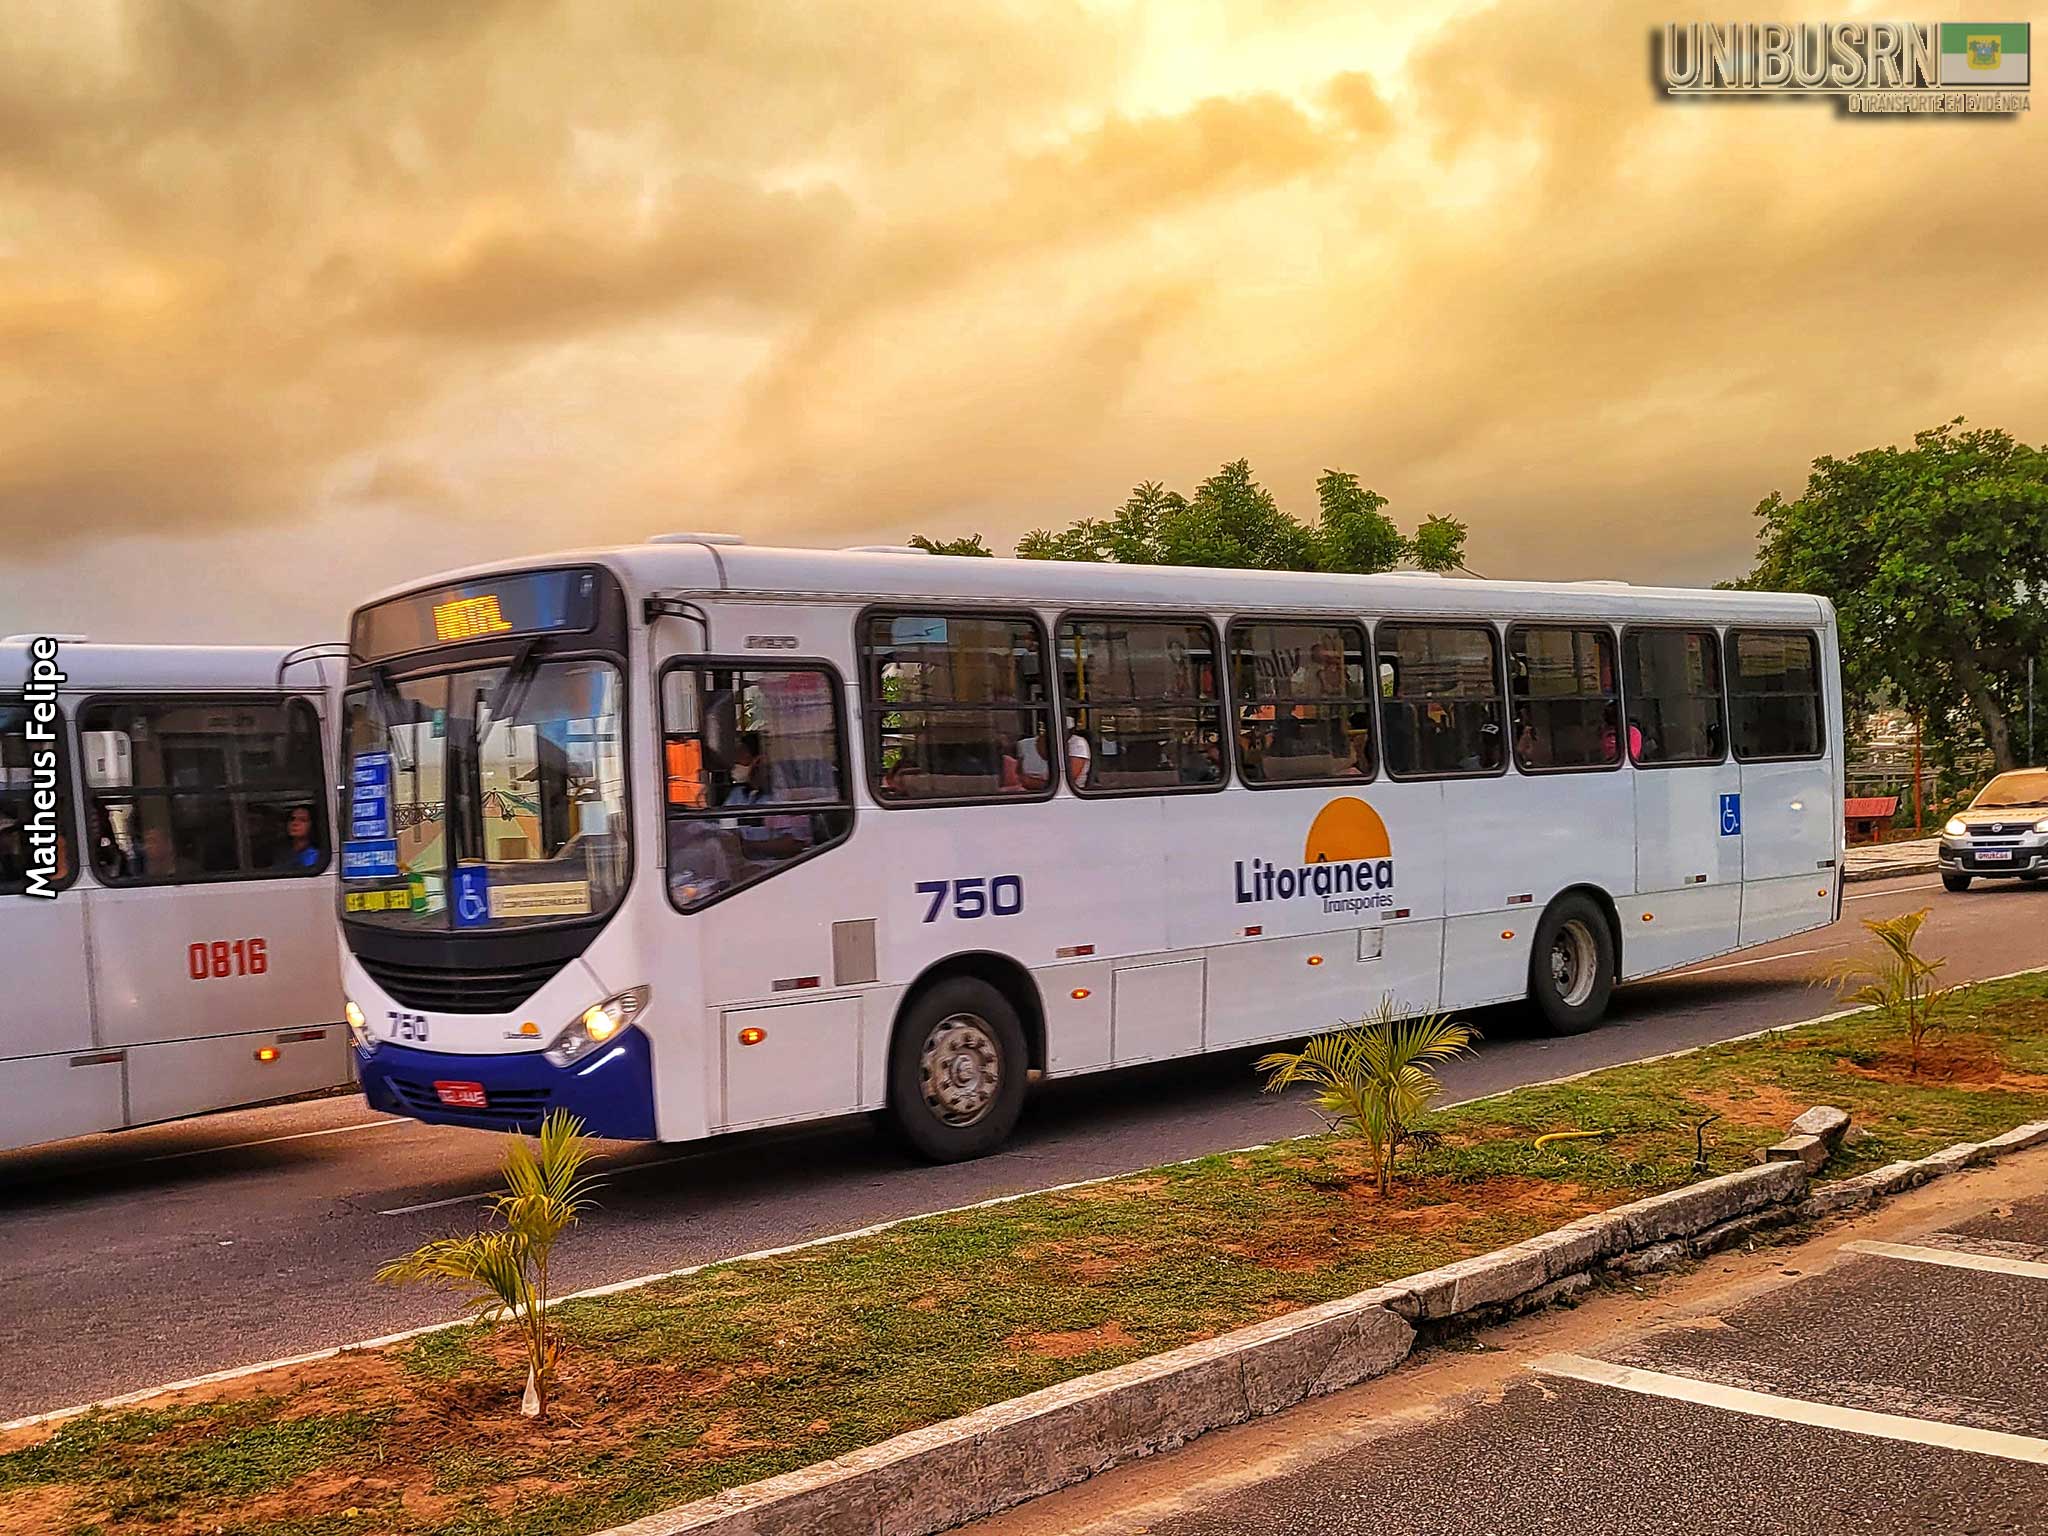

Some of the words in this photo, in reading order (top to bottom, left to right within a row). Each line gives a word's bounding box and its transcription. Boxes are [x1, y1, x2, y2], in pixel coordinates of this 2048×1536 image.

[915, 874, 1024, 923] 750
[1235, 852, 1395, 904] Litorânea
[1322, 892, 1394, 915] Transportes
[189, 938, 267, 979] 0816
[386, 1011, 429, 1042] 750
